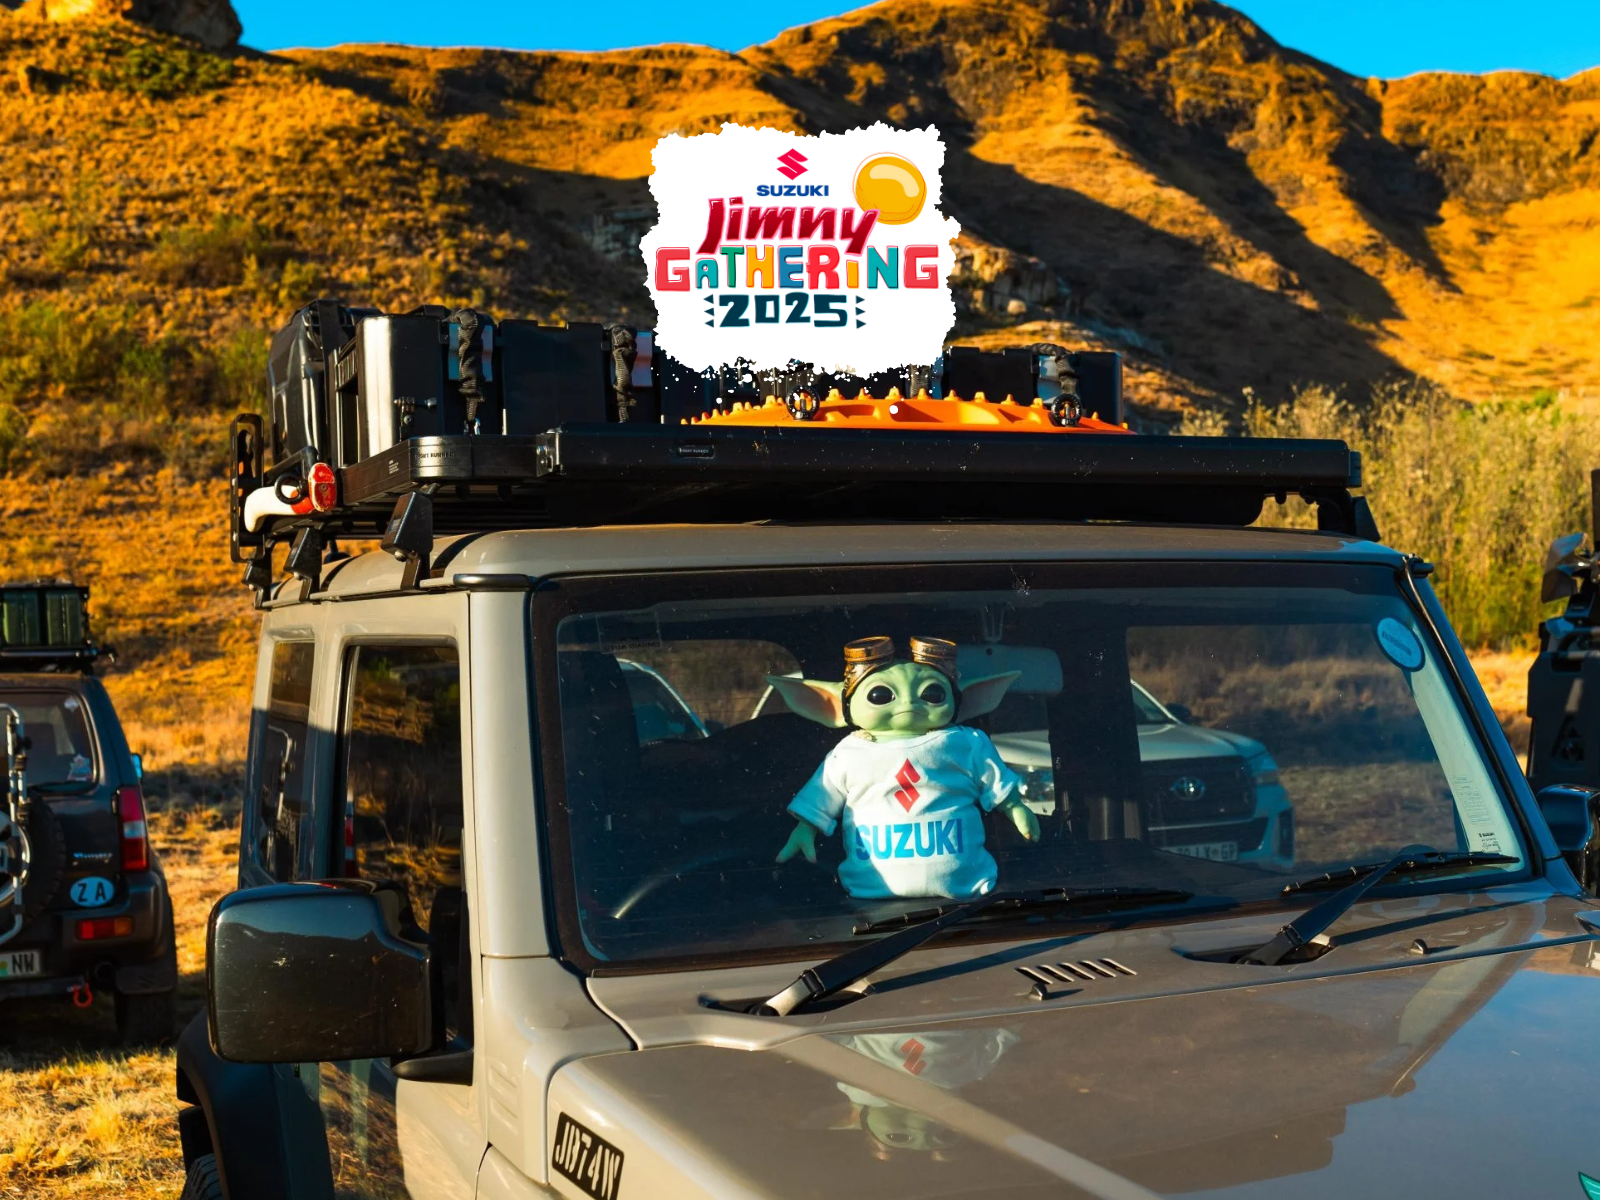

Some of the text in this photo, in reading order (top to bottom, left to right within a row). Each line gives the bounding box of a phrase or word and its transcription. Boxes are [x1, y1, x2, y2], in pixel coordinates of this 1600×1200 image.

[854, 818, 963, 861] SUZUKI
[11, 953, 35, 974] NW
[554, 1121, 621, 1200] JB74W
